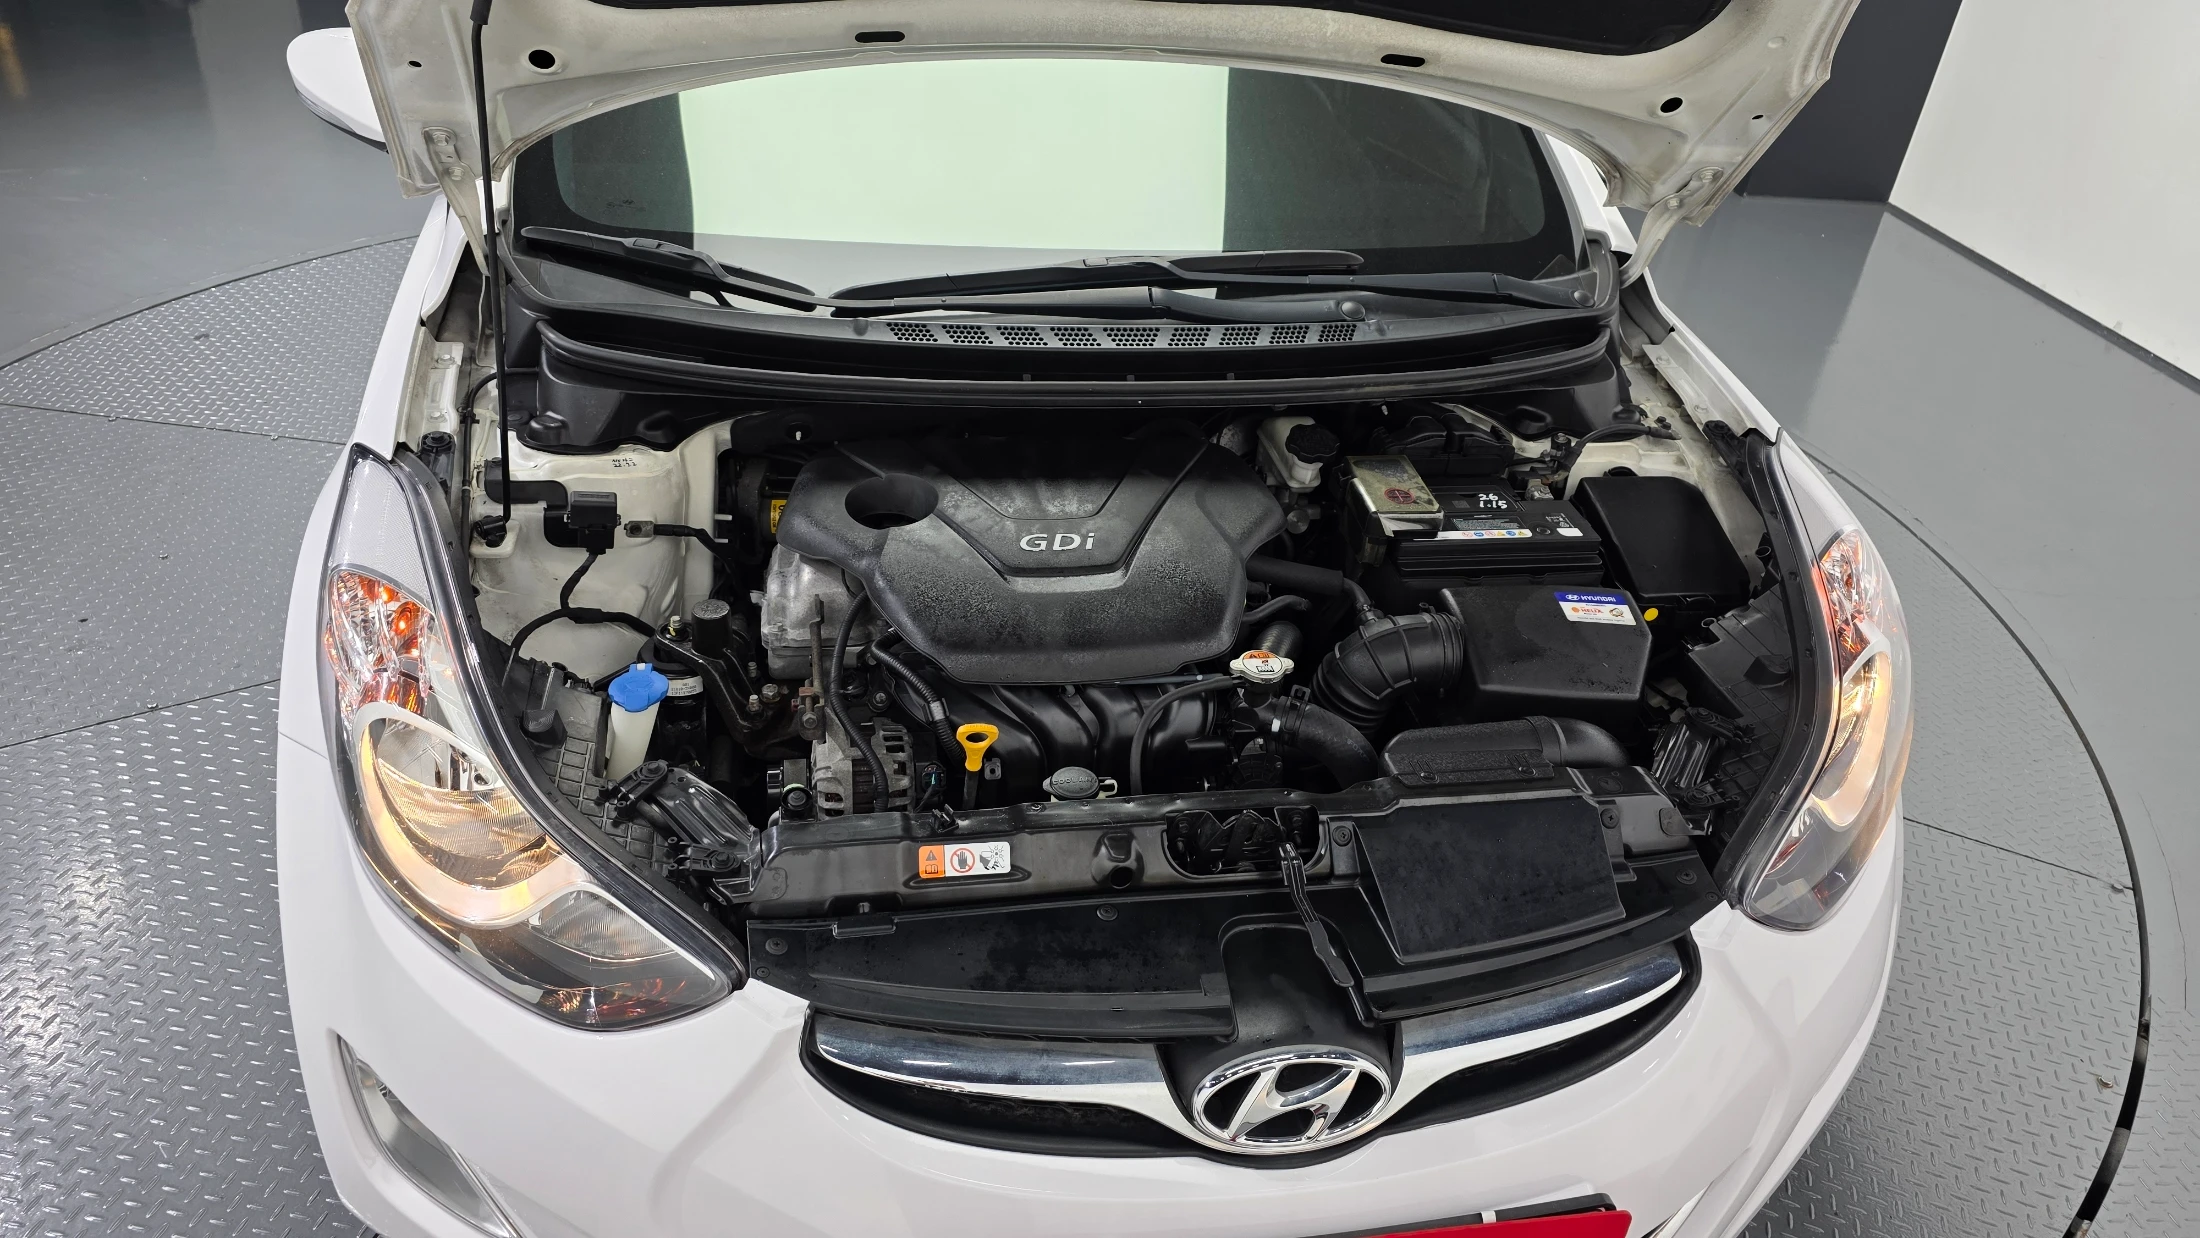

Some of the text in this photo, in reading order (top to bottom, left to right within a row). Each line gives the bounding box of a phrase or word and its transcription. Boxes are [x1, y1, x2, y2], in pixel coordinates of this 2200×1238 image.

[1478, 493, 1498, 501] 26
[1479, 500, 1508, 509] 1.15
[1019, 532, 1095, 552] GDi
